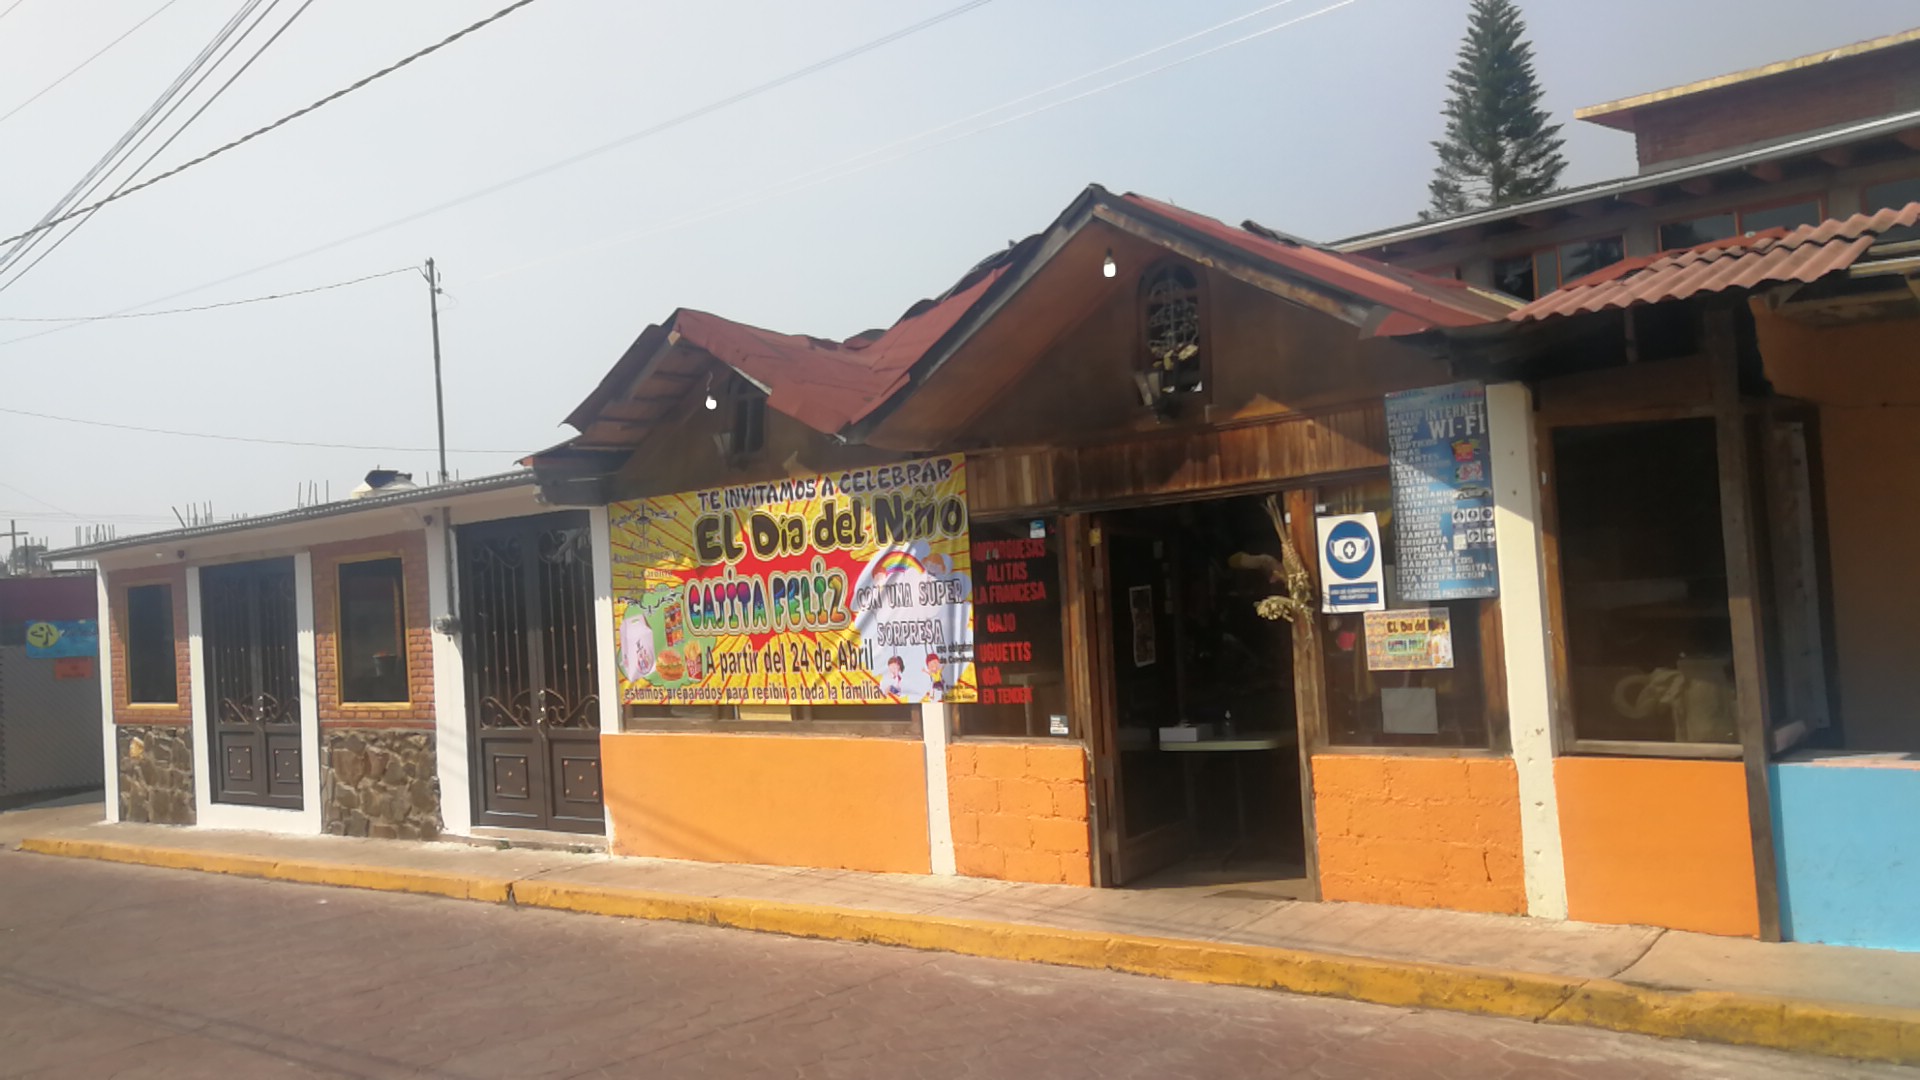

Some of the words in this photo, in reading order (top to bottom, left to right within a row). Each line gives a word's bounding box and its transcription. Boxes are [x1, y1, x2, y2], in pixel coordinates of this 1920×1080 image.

[1425, 401, 1483, 420] INTERNET
[1428, 414, 1485, 440] WI-FI
[697, 491, 721, 511] TE
[725, 478, 816, 508] INVITAMOS
[821, 476, 834, 497] A
[839, 458, 952, 496] CELEBRAR
[814, 500, 866, 549] del
[875, 484, 964, 544] Niño
[986, 561, 1028, 582] ALITAS
[857, 585, 882, 611] CON
[888, 582, 913, 608] UNA
[918, 578, 963, 606] SUPER
[990, 580, 1047, 603] FRANCESA
[877, 619, 944, 646] SORPRESA
[986, 612, 1016, 633] GAJO
[706, 646, 715, 674] A
[720, 642, 757, 681] partir
[764, 645, 786, 673] del
[791, 642, 810, 672] 24
[814, 642, 832, 671] de
[838, 638, 874, 671] Abril
[976, 641, 1032, 663] UGUETTS
[624, 686, 664, 701] estamos
[667, 683, 722, 702] preparados
[726, 686, 749, 704] para
[752, 683, 787, 700] recibir
[790, 688, 797, 700] a
[800, 683, 825, 700] toda
[828, 682, 837, 699] la
[840, 681, 880, 699] familia
